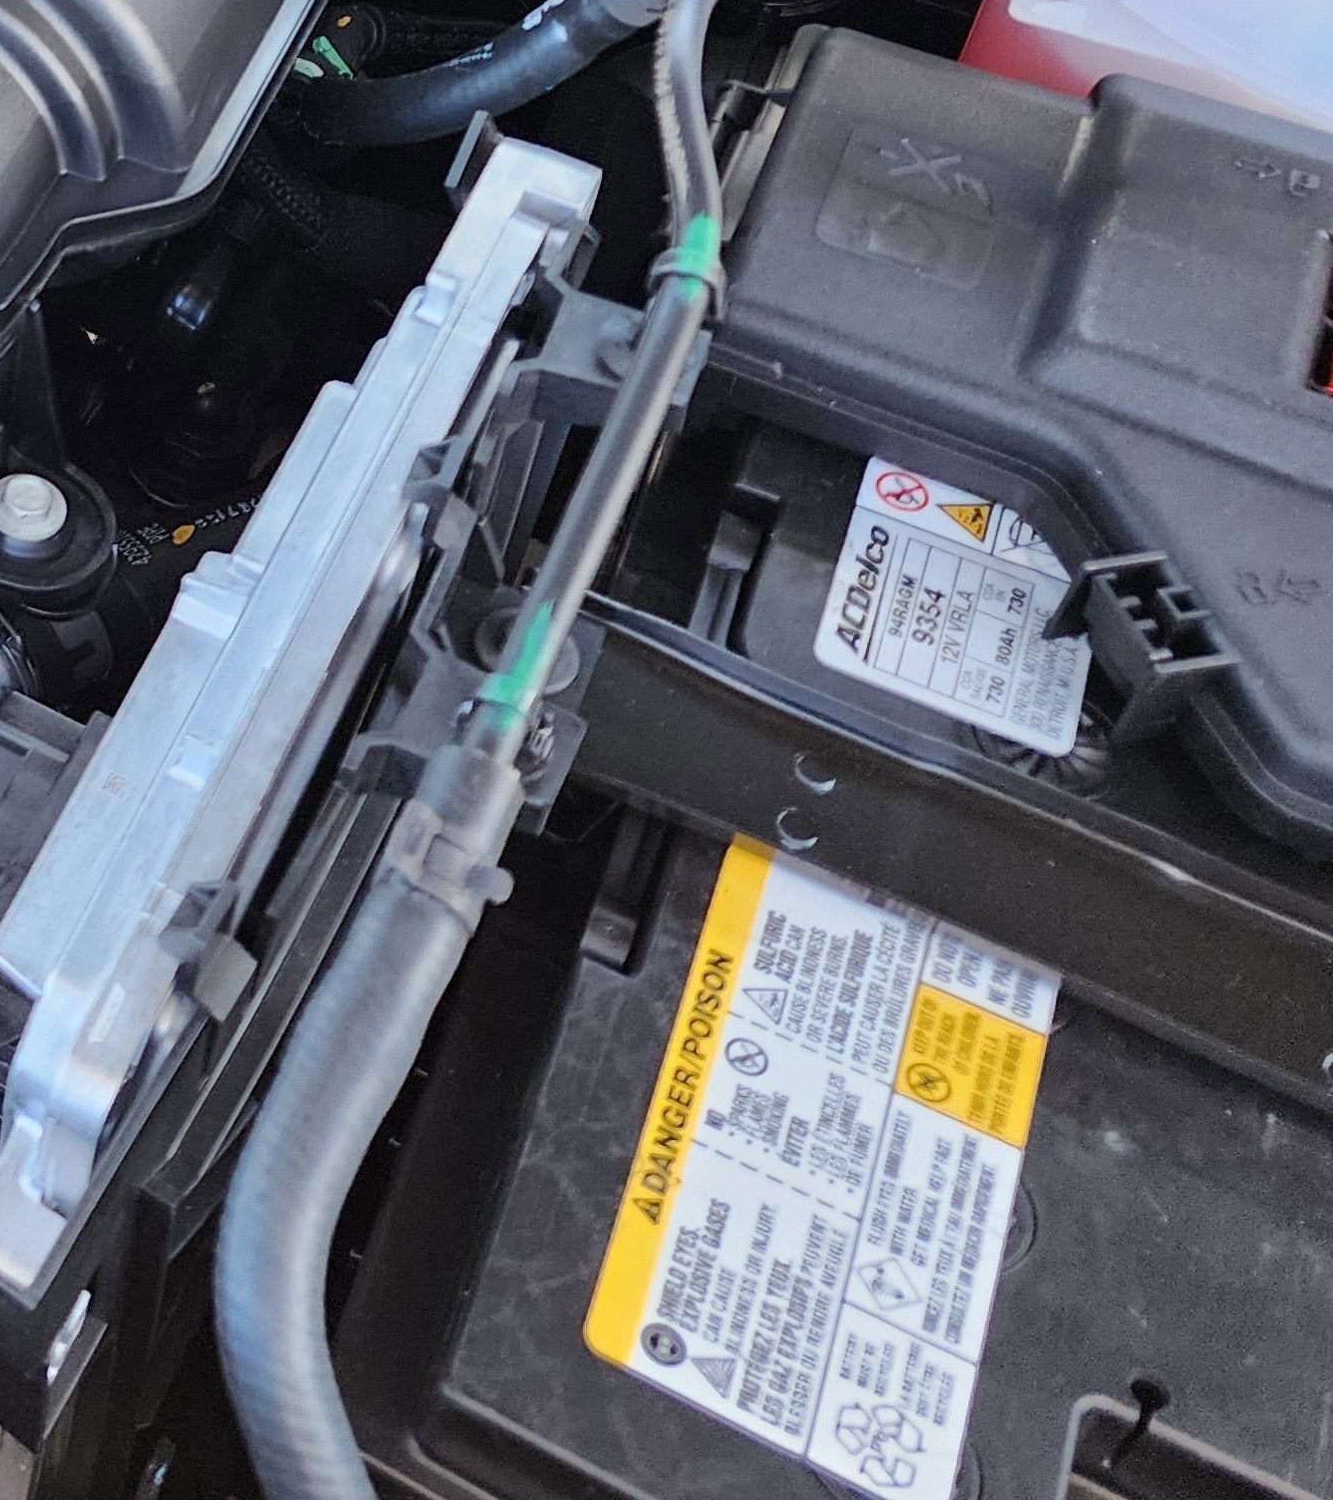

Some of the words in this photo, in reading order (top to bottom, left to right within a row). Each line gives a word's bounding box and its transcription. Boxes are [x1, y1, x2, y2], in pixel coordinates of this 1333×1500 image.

[837, 525, 889, 655] ACDelco
[886, 573, 917, 639] 94RAGM
[947, 586, 974, 635] VRLA
[1006, 585, 1026, 616] 730
[910, 585, 946, 647] 9354
[940, 636, 963, 667] 12V
[984, 673, 1005, 706] 730
[752, 908, 787, 976] SULFURIC
[784, 922, 806, 952] CAN
[795, 925, 828, 995] BLINDNESS
[773, 947, 799, 985] ACID
[836, 928, 874, 1009] SULFURIQUE
[870, 963, 890, 984] LA
[784, 991, 810, 1035] CAUSE
[810, 975, 836, 1026] SEVERE
[858, 980, 885, 1032] CAUSER
[805, 1022, 824, 1045] OR
[849, 1029, 872, 1065] PEUT
[642, 948, 733, 1198] DANGER/POISON
[676, 1245, 718, 1334] EXPLOSIVE
[699, 1196, 731, 1251] GASES
